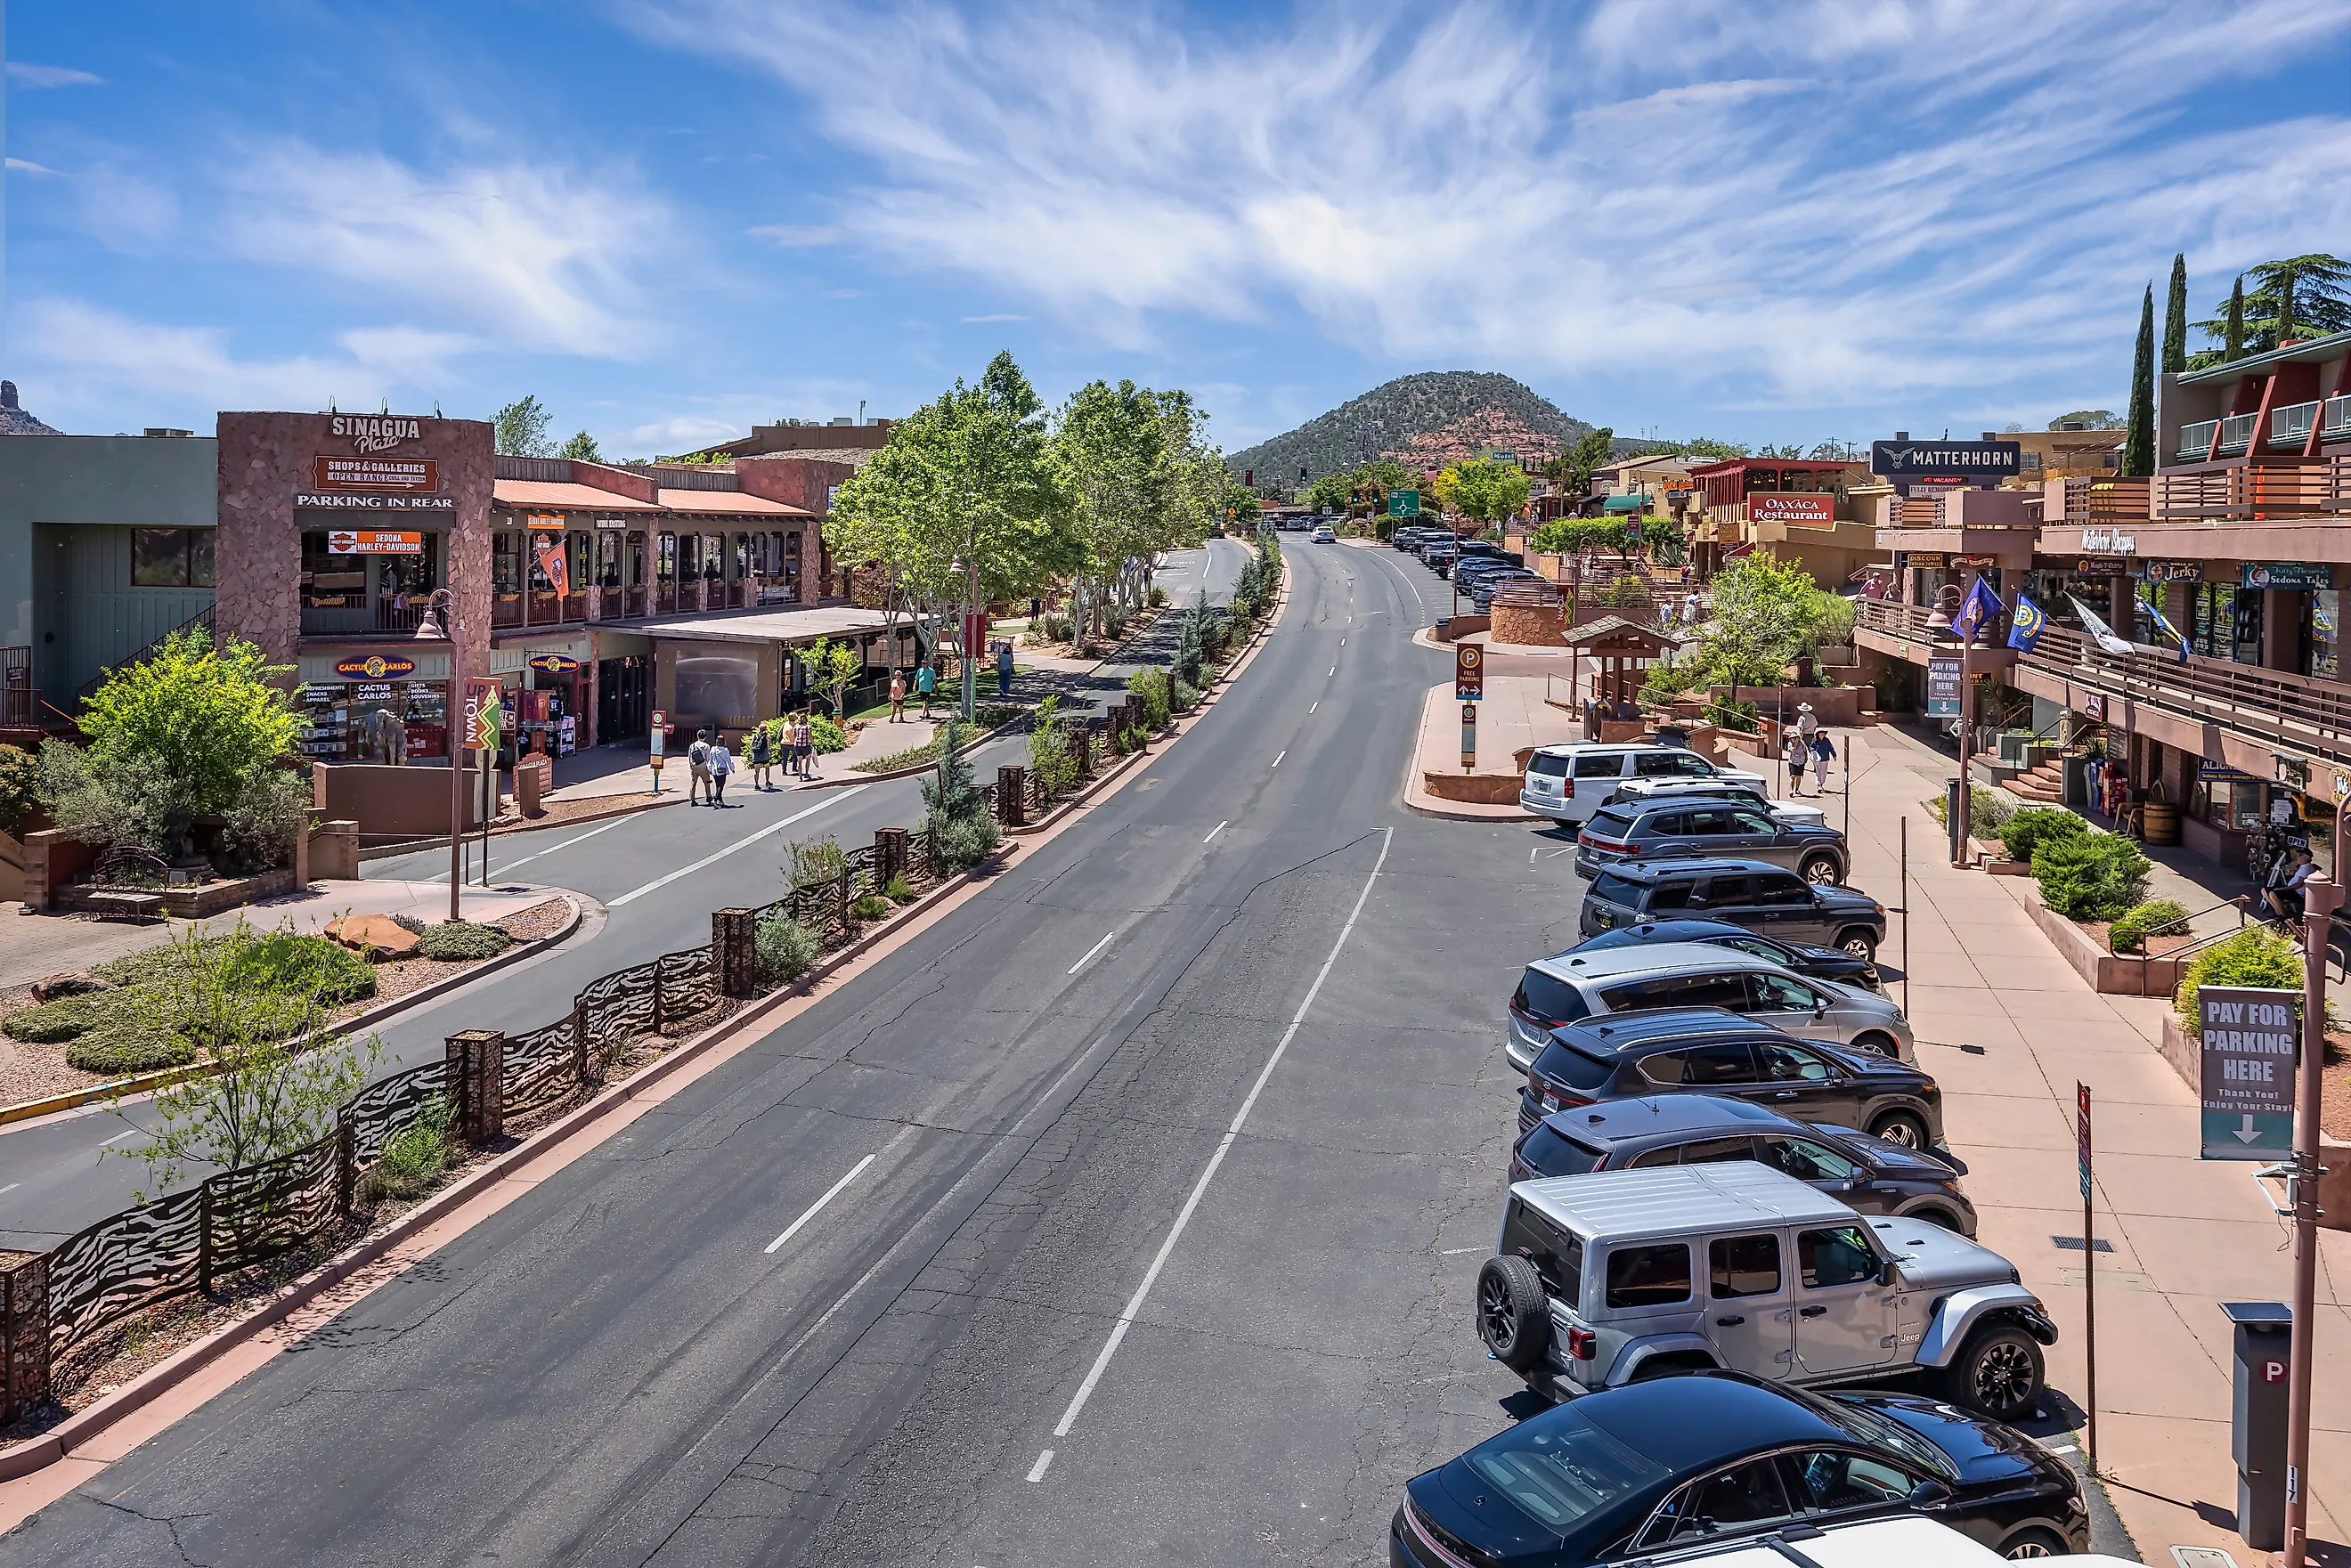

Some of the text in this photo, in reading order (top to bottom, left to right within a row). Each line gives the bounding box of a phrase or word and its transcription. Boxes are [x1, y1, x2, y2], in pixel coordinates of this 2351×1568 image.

[332, 417, 420, 438] SINAGUA
[354, 435, 401, 454] Plaza
[1913, 451, 2013, 466] MATTERHORN
[328, 461, 361, 471] SHOPS
[371, 463, 426, 474] GALLERIES
[332, 473, 355, 481] OPEN
[360, 474, 389, 482] RANGE
[297, 495, 453, 508] PARKING IN REAR
[1765, 499, 1819, 511] OAXACA
[1753, 509, 1828, 521] Restaurant
[357, 543, 419, 552] HARLEY-DAVIDSON
[2164, 565, 2200, 581] Jerky
[1466, 652, 1476, 664] P
[1931, 662, 1959, 670] PAY FOR
[1930, 672, 1960, 680] PARKING
[467, 684, 486, 696] UP
[1936, 682, 1954, 690] HERE
[358, 692, 392, 700] CARLOS
[464, 695, 478, 743] TOWN
[2289, 836, 2306, 847] OPEN
[2207, 1002, 2287, 1026] PAY FOR
[2203, 1029, 2292, 1054] PARKING
[2223, 1058, 2274, 1082] HERE
[2217, 1088, 2279, 1099] Thank You!
[2203, 1101, 2233, 1109] Enjoy
[2264, 1103, 2292, 1112] Stay!
[1900, 1334, 1920, 1342] Jeep
[2267, 1362, 2283, 1382] P
[2288, 1466, 2296, 1501] 117
[1414, 1510, 1470, 1562] LINCOLN
